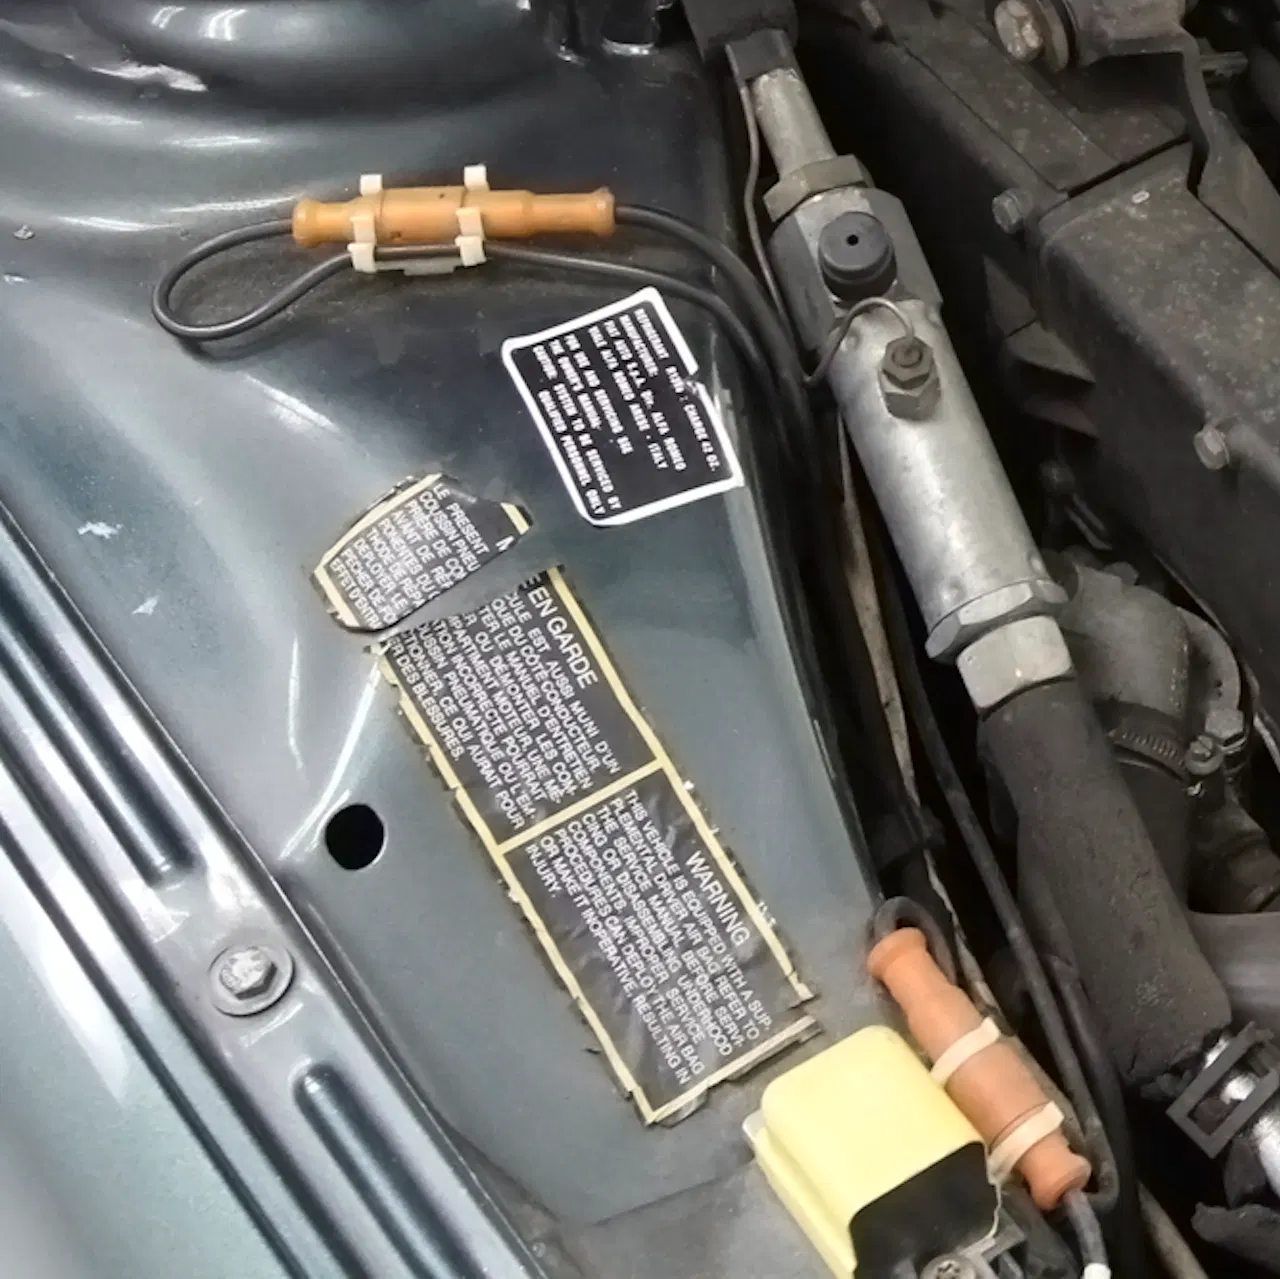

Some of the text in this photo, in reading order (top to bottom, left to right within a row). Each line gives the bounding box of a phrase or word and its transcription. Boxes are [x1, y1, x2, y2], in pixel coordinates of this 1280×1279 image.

[583, 369, 601, 387] AND
[651, 412, 670, 435] ALFA
[571, 417, 586, 432] TO
[585, 448, 614, 493] SERVICED
[607, 496, 622, 509] BY
[585, 489, 606, 514] ONLY
[647, 442, 669, 469] ITALY
[415, 544, 436, 564] DE
[431, 538, 452, 558] DE
[507, 624, 528, 647] DU
[527, 586, 558, 618] EN
[546, 616, 598, 689] GARDE
[396, 654, 421, 685] DES
[412, 682, 465, 761] BLESSURES.
[443, 671, 506, 761] PNEUMATIQUE
[498, 761, 518, 783] OU
[451, 653, 508, 736] INCORRECTE
[501, 735, 548, 800] POURRAIT
[474, 631, 495, 653] OU
[535, 733, 559, 761] LES
[493, 632, 513, 651] LE
[505, 650, 541, 706] MANUEL
[537, 705, 593, 789] D'ENTRETIEN
[527, 627, 552, 653] EST
[545, 660, 575, 699] AUSSI
[569, 700, 600, 738] MUNI
[594, 740, 621, 774] D'UN
[438, 696, 459, 717] CE
[451, 716, 474, 743] QUI
[466, 744, 503, 789] AURAIT
[494, 790, 525, 830] POUR
[526, 748, 552, 779] UNE
[525, 842, 562, 892] INJURY.
[596, 804, 620, 834] THE
[613, 836, 653, 892] SERVICE
[648, 894, 685, 949] MANUAL
[681, 950, 719, 1004] BEFORE
[609, 797, 658, 874] PLEMENTAL
[653, 872, 689, 921] DRIVER
[682, 922, 704, 946] AIR
[715, 975, 748, 1021] REFER
[742, 1018, 760, 1040] TO
[624, 789, 648, 821] THIS
[642, 820, 681, 875] VEHICLE
[673, 875, 689, 891] IS
[681, 890, 727, 955] EQUIPPED
[718, 952, 748, 989] WITH
[739, 990, 754, 1002] A
[686, 850, 752, 948] WARNING
[539, 835, 560, 858] OR
[552, 856, 583, 896] MAKE
[573, 894, 591, 908] IT
[632, 993, 682, 1069] RESULTING
[674, 1066, 692, 1085] IN
[554, 828, 708, 1076] PROCEDURES CAN DEPLOY THE AIR BAG
[581, 813, 733, 1056] CING OR DISASSEMBLING UNDERHOOD
[623, 915, 670, 984] IMPROPER
[665, 987, 707, 1044] SERVICE
